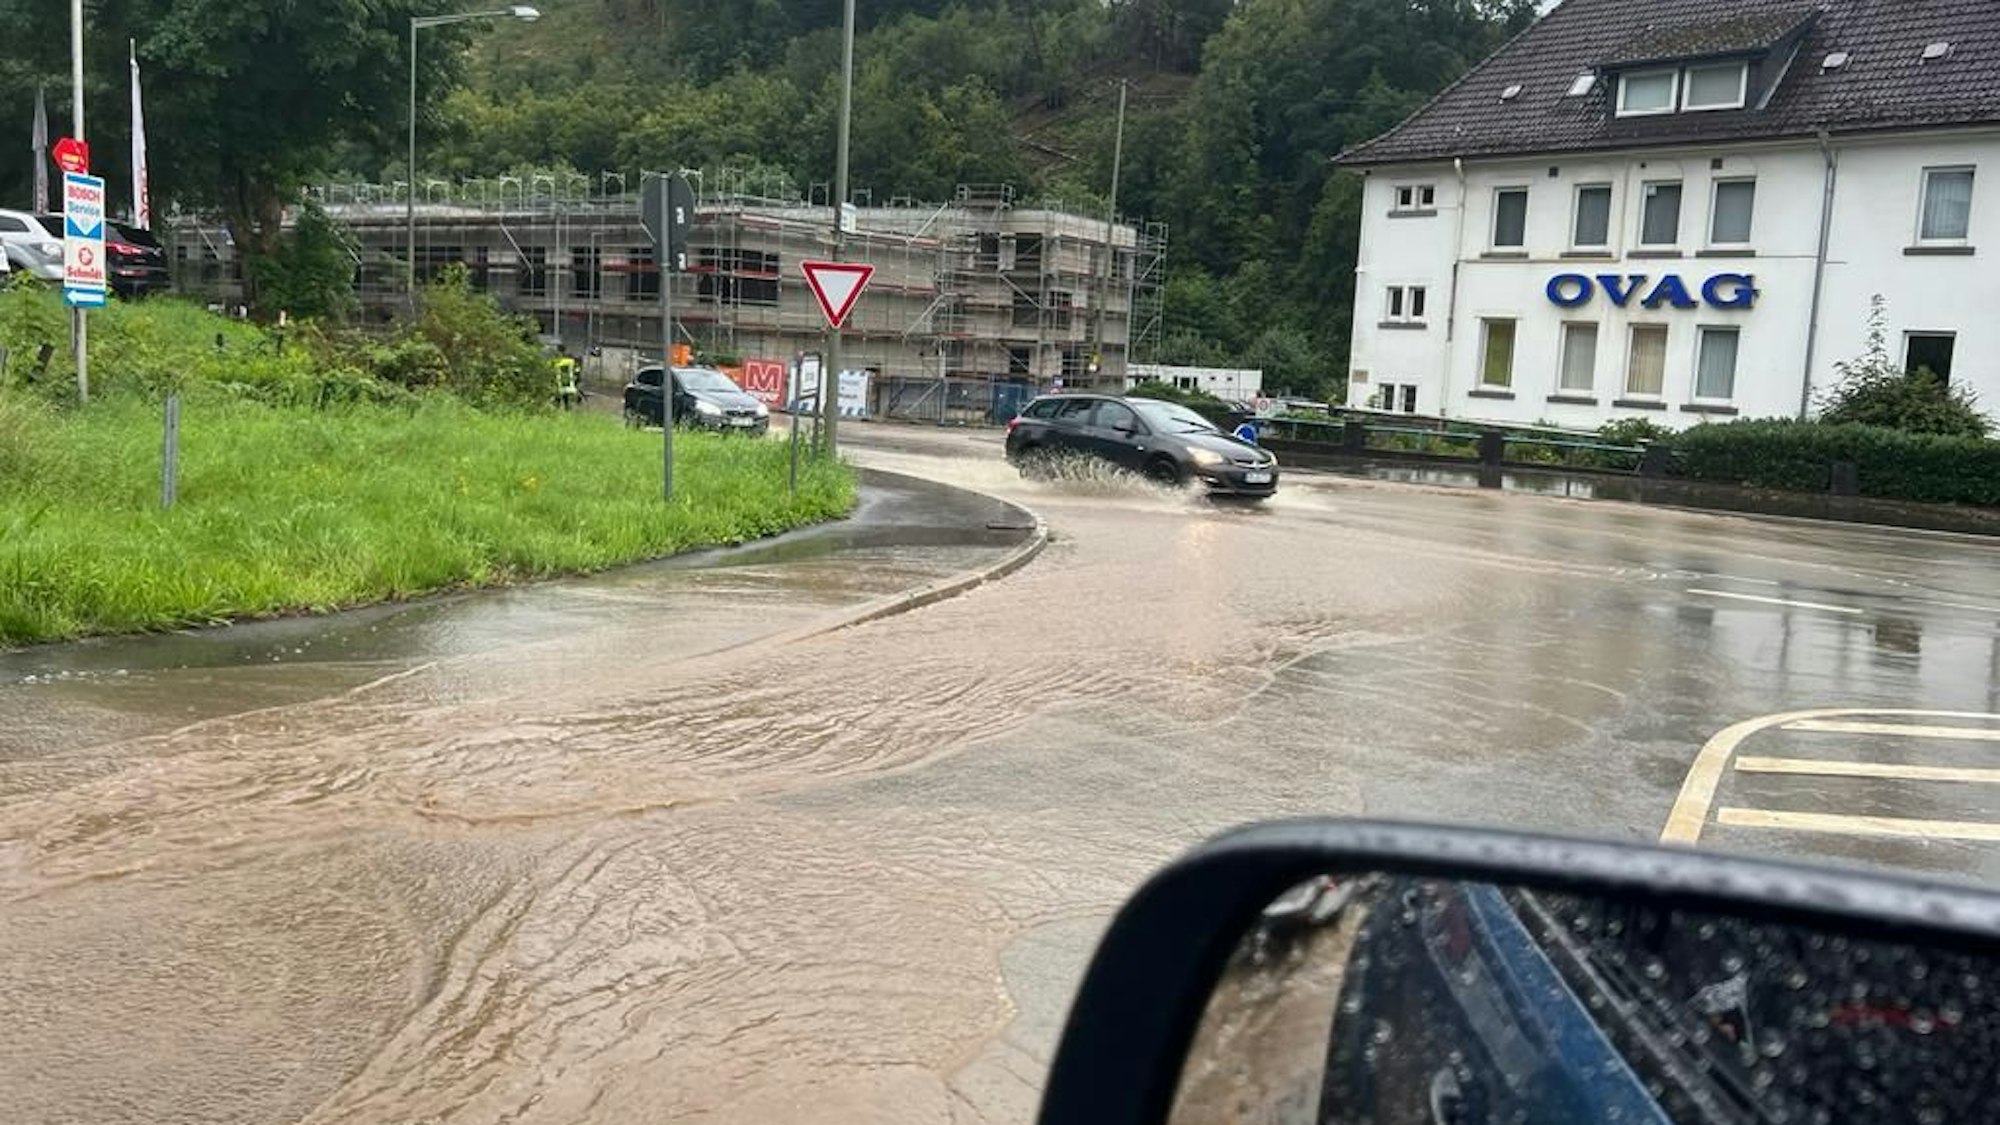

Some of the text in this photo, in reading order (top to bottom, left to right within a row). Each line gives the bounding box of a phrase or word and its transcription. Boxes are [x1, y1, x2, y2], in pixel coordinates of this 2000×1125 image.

[68, 184, 100, 202] BOSCH
[68, 201, 100, 217] Service
[67, 265, 102, 279] Schmidt
[1546, 273, 1760, 309] OVAG
[746, 362, 783, 392] M
